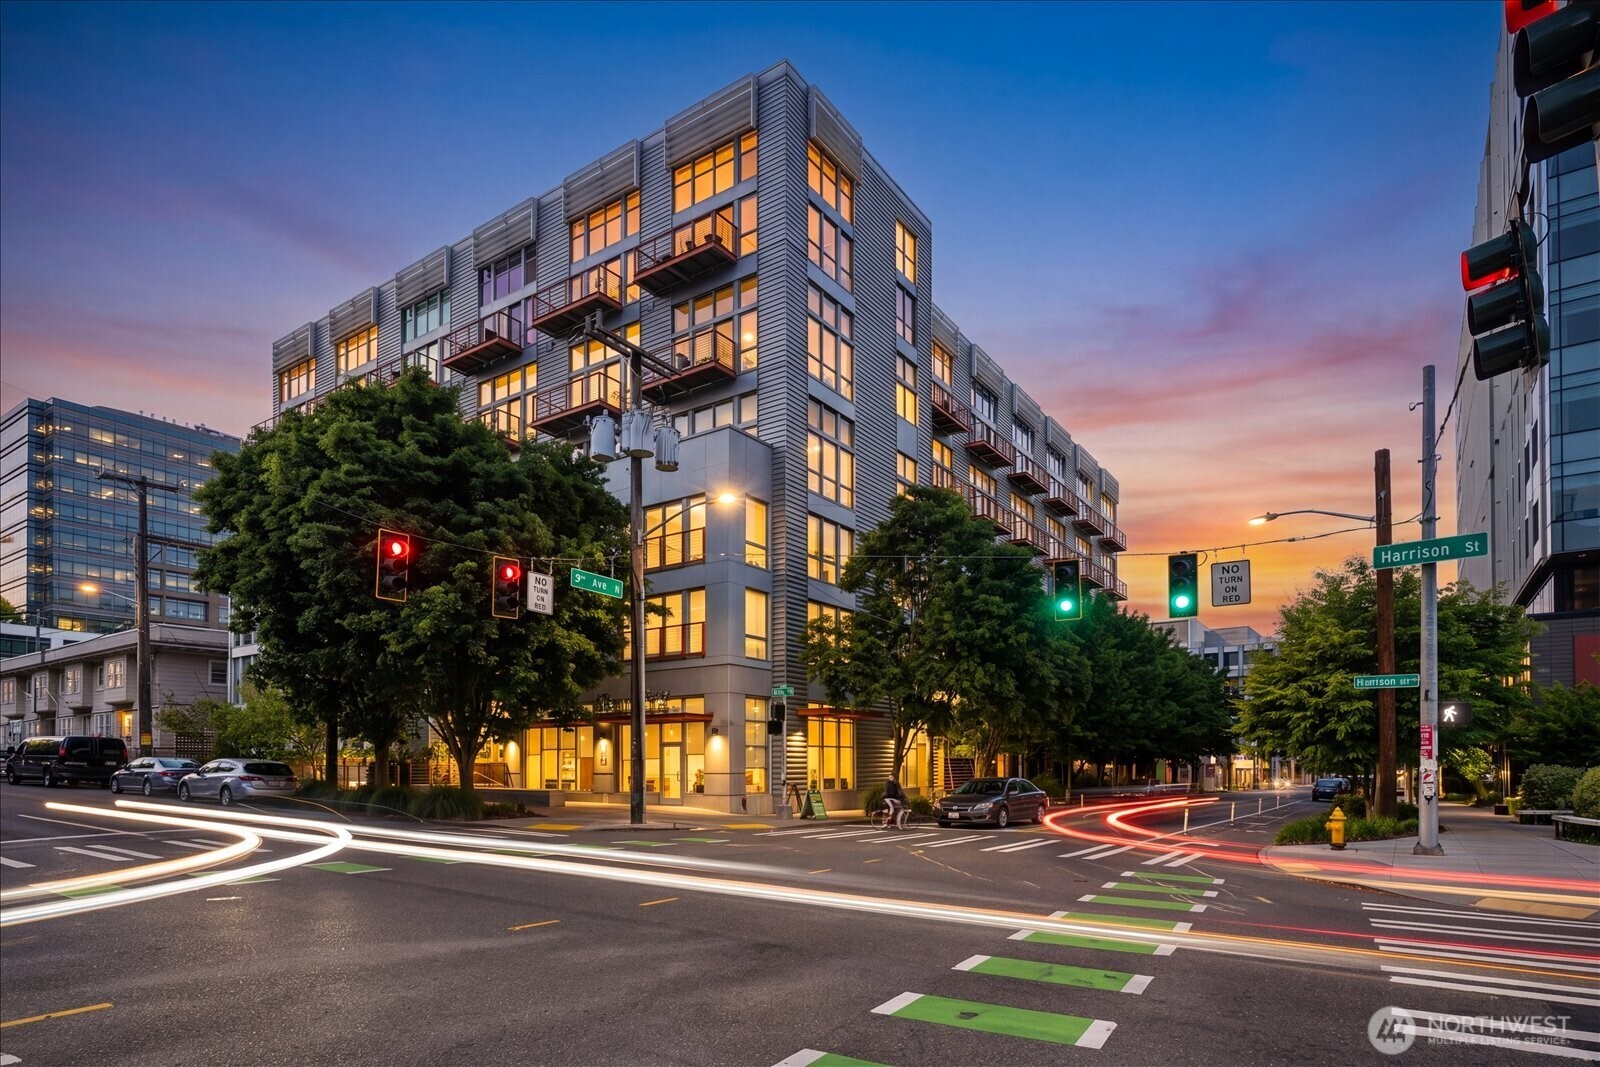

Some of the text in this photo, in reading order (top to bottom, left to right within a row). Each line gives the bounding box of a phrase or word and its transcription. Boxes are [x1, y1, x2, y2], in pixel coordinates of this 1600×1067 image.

[1381, 541, 1479, 563] Harrison St
[1222, 565, 1239, 574] NO
[535, 576, 547, 586] NO
[1219, 576, 1242, 584] TURN
[533, 586, 548, 595] TURN
[592, 578, 607, 590] Ave
[614, 585, 620, 594] N
[1225, 585, 1237, 593] ON
[1223, 595, 1240, 603] RED
[534, 602, 546, 611] RED
[1356, 677, 1396, 687] Harrison
